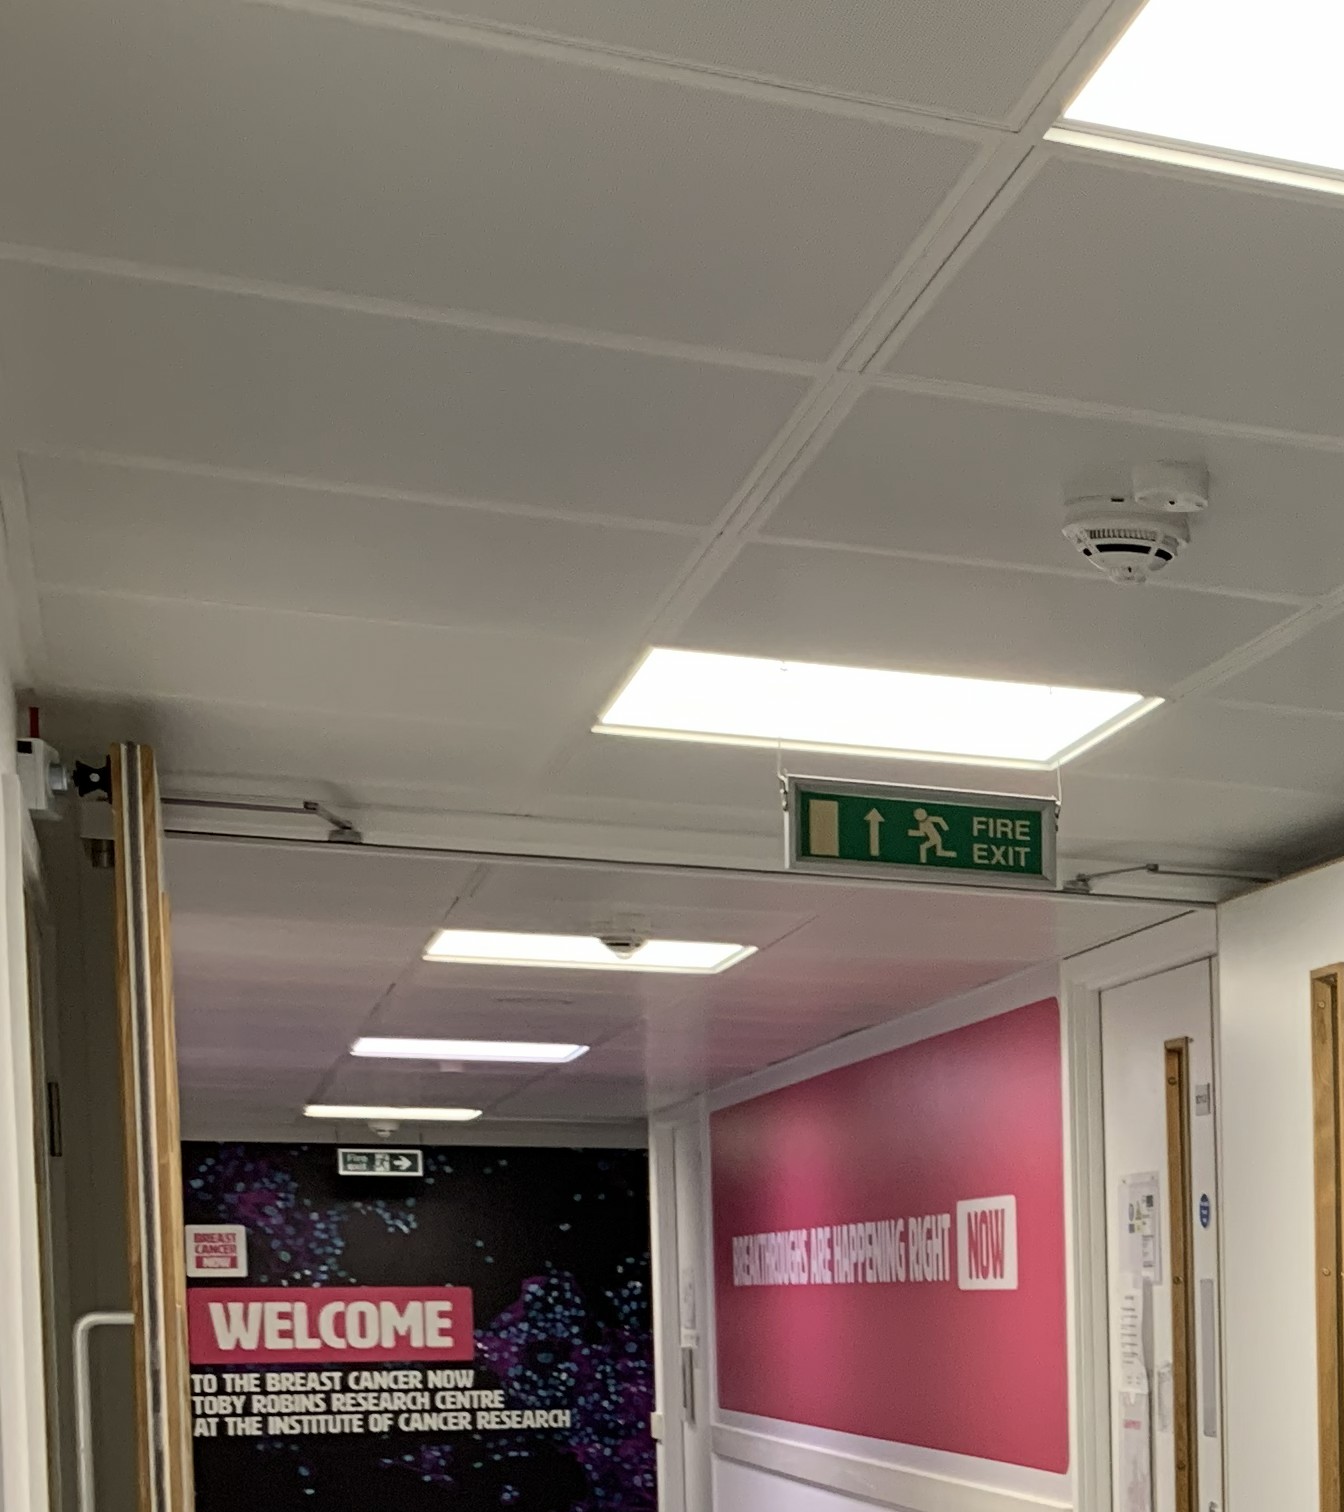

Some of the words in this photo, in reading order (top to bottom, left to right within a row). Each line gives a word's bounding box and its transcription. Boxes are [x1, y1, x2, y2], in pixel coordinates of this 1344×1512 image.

[973, 817, 1031, 840] FIRE
[973, 844, 1031, 867] EXIT
[194, 1233, 236, 1243] BREAST
[195, 1244, 237, 1254] CANCER
[810, 1225, 833, 1285] ARE
[832, 1218, 906, 1283] HAPPENING
[908, 1213, 951, 1282] RIGHT
[967, 1208, 1005, 1280] NOW
[203, 1256, 231, 1267] NOW
[208, 1301, 453, 1350] WELCOME
[191, 1374, 218, 1393] TO
[222, 1373, 261, 1393] THE
[265, 1372, 343, 1392] BREAST
[348, 1371, 423, 1390] CANCER
[427, 1370, 475, 1388] NOW
[192, 1395, 246, 1415] TOBY
[251, 1394, 327, 1413] ROBINS
[331, 1391, 431, 1412] RESEARCH
[435, 1390, 505, 1409] CENTRE
[193, 1417, 219, 1437] AT
[224, 1416, 262, 1436] THE
[267, 1414, 364, 1435] INSTITUTE
[368, 1413, 394, 1432] OF
[398, 1412, 472, 1431] CANCER
[476, 1410, 571, 1430] RESEARCH
